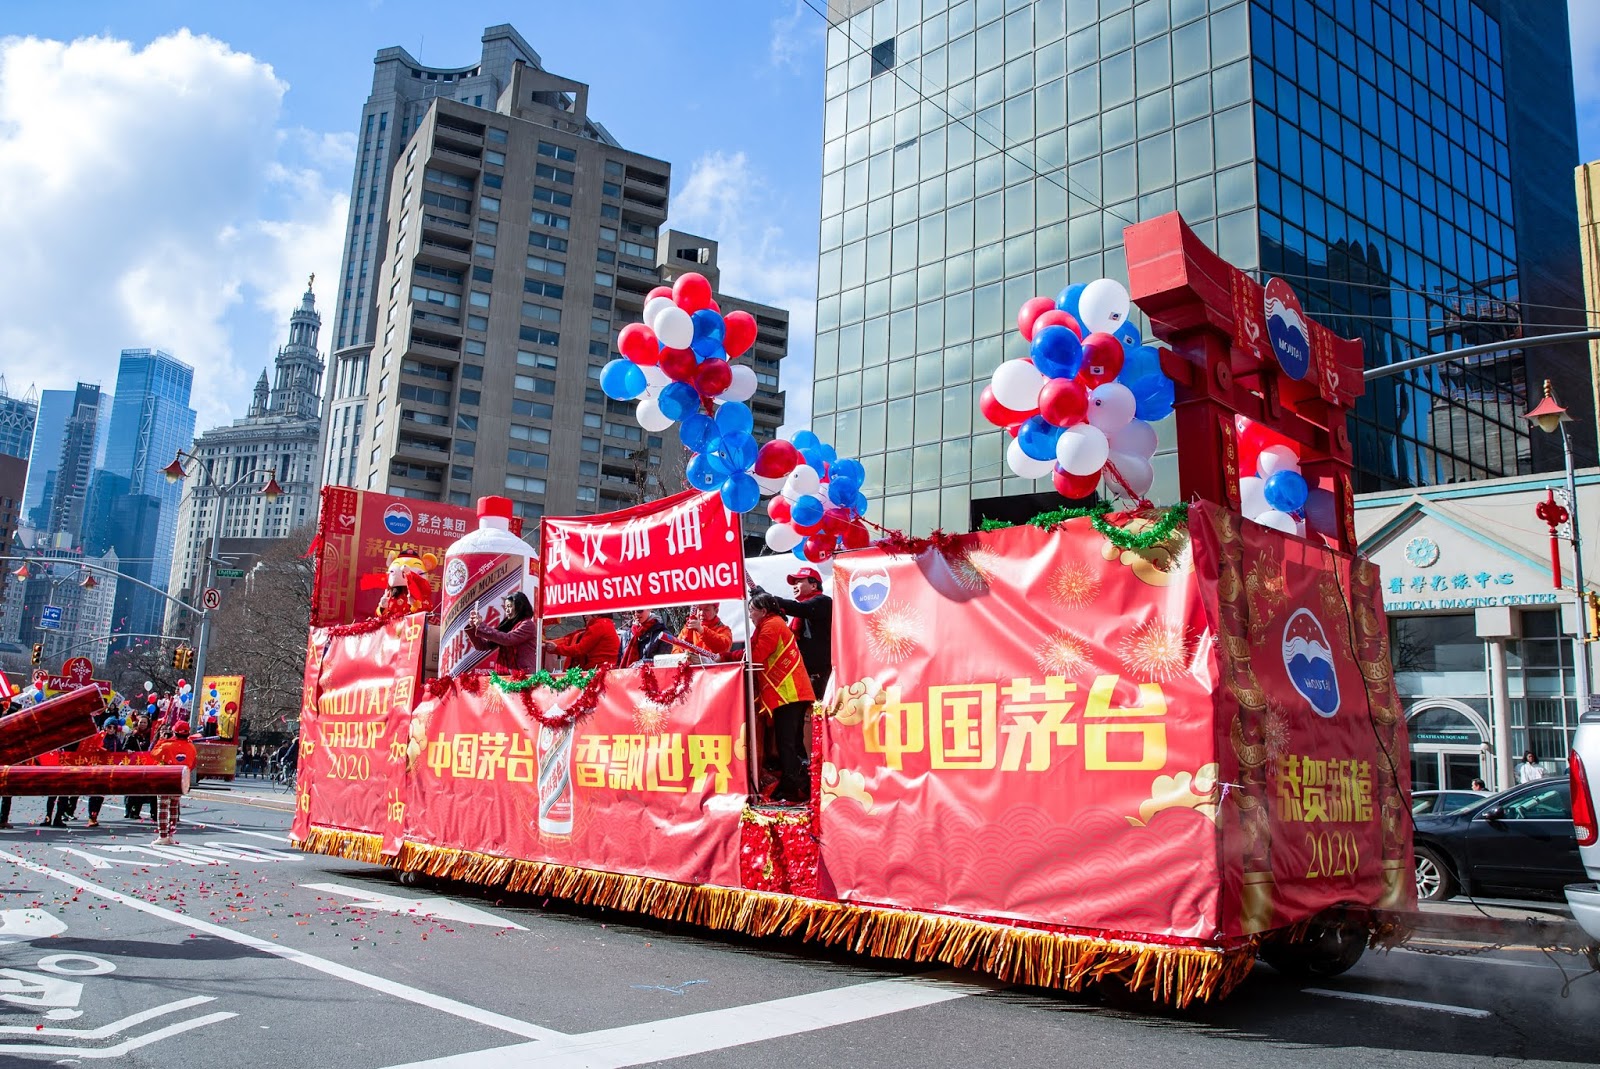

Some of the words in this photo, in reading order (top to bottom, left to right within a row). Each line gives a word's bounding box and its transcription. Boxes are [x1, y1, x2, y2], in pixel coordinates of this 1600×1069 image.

[416, 526, 441, 536] MOUTAI
[417, 513, 466, 532] 茅台集团
[475, 563, 509, 593] MOUTAI
[545, 579, 599, 606] WUHAN
[602, 573, 644, 600] STAY
[647, 561, 739, 595] STRONG!
[1384, 600, 1435, 612] MEDICAL
[1439, 596, 1497, 610] IMAGING
[1500, 593, 1558, 606] CENTER
[319, 684, 390, 716] MOUTAI
[321, 721, 387, 750] GROUP
[387, 616, 422, 824] 中国加油
[862, 673, 1168, 772] 中国茅台
[327, 753, 370, 781] 2020
[427, 731, 534, 783] 中国茅台
[575, 733, 733, 794] 香飘世界
[1277, 754, 1374, 823] 恭贺新禧
[1305, 830, 1360, 879] 2020
